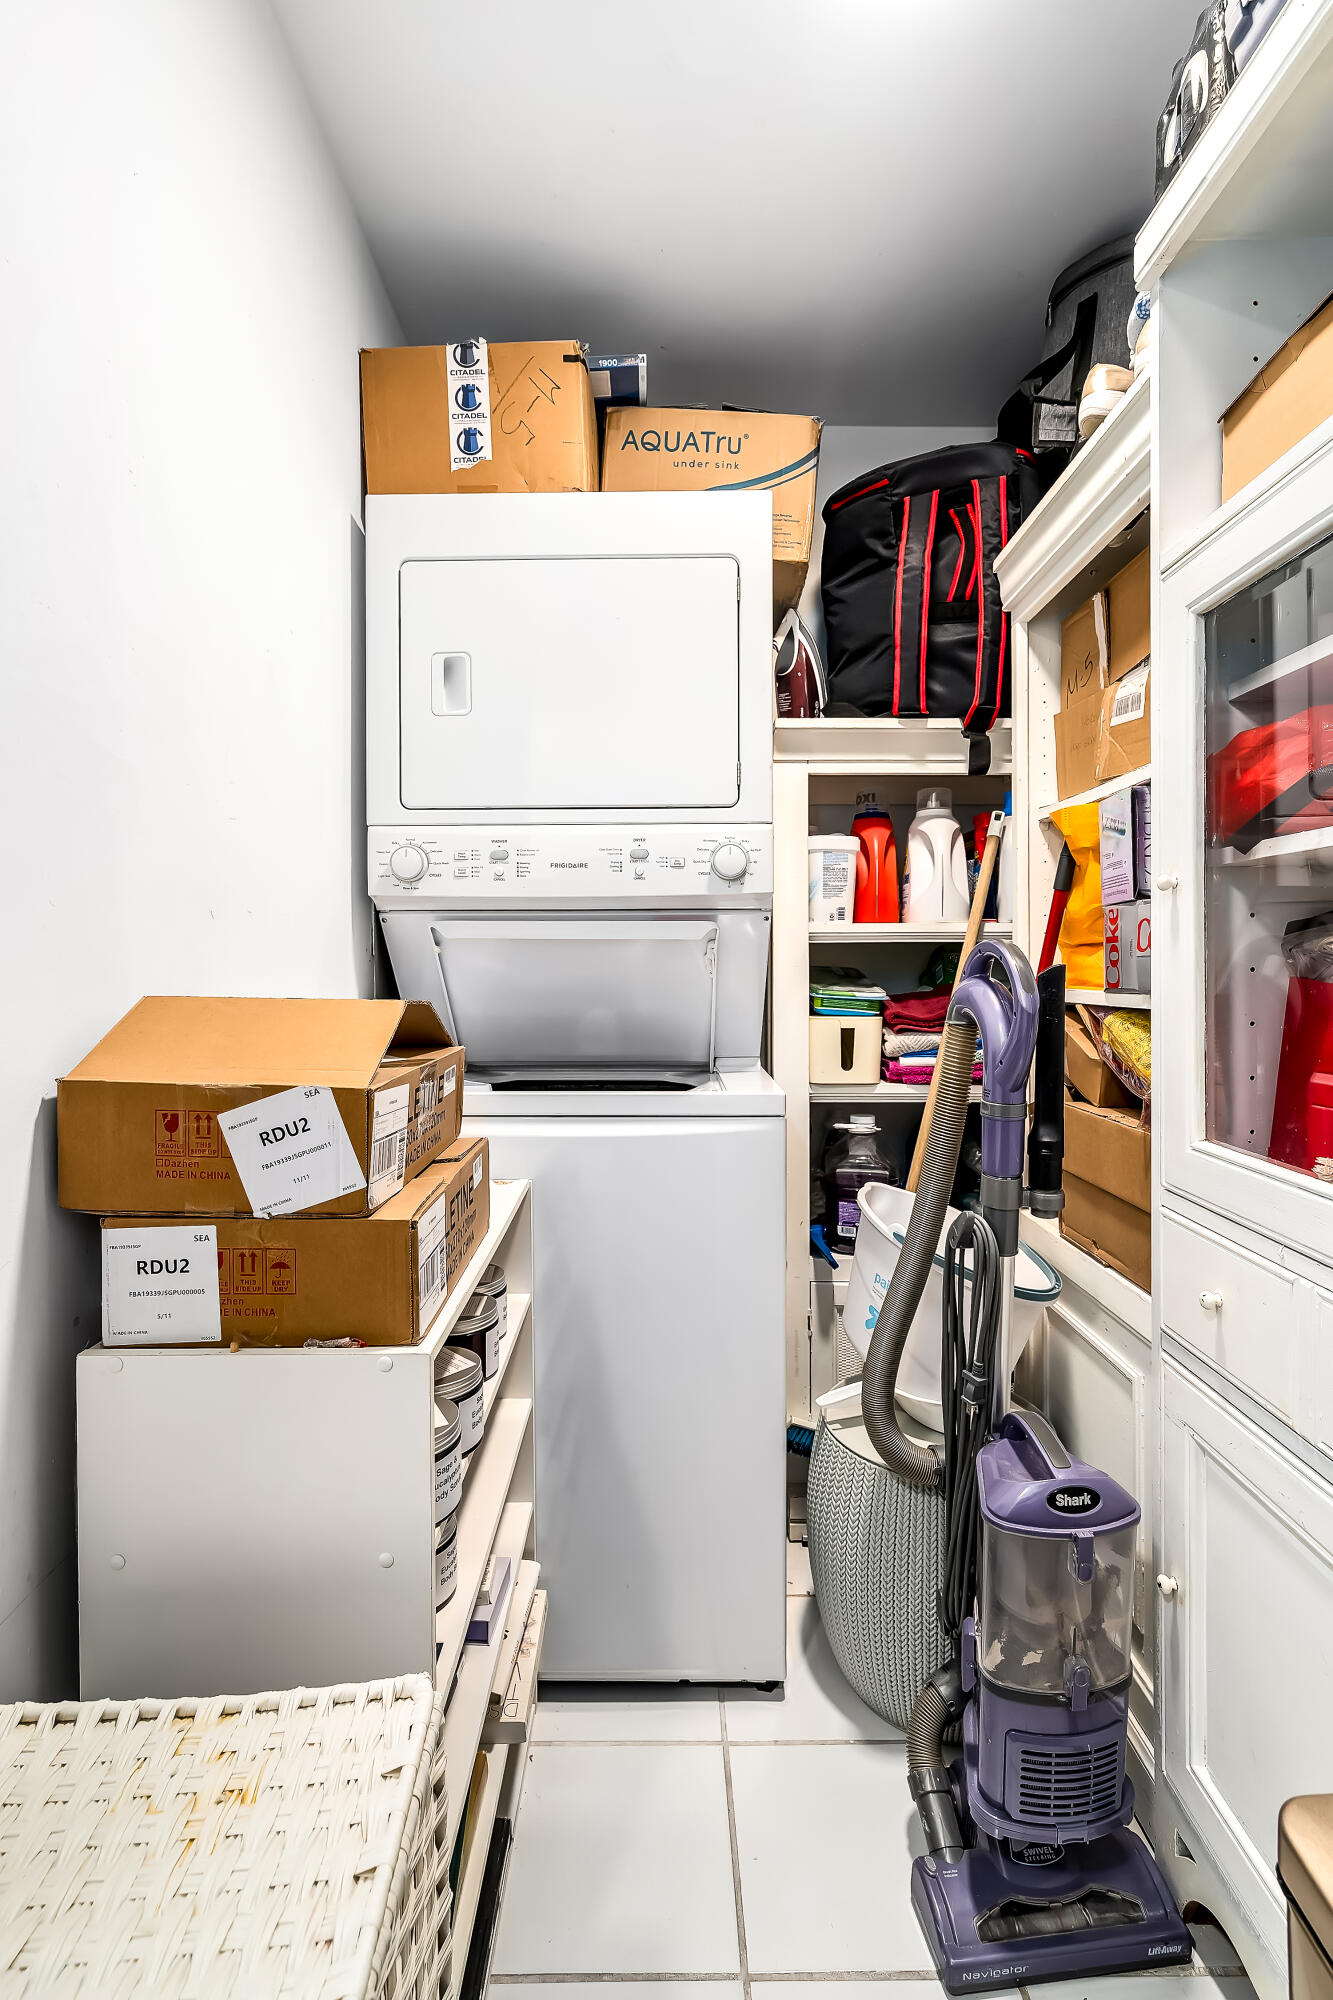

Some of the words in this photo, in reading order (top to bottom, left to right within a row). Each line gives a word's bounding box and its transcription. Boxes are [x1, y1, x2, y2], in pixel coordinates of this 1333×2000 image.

[598, 358, 618, 367] 1900
[453, 456, 487, 464] CITADE
[672, 460, 710, 469] under
[714, 460, 740, 470] sink
[1105, 907, 1121, 989] Coke
[304, 1087, 321, 1099] SEA
[259, 1117, 311, 1147] RDU2
[156, 1170, 185, 1179] MADE
[187, 1170, 197, 1179] IN
[199, 1171, 231, 1180] CHINA
[293, 1173, 310, 1184] 11/11
[193, 1234, 211, 1242] SEA
[136, 1258, 190, 1275] RDU2
[221, 1297, 244, 1306] zhen
[156, 1312, 172, 1320] 5/11
[232, 1307, 242, 1317] IN
[244, 1307, 276, 1317] CHINA
[436, 1461, 453, 1478] Sage
[435, 1489, 449, 1503] ody
[1055, 1492, 1092, 1507] Shark
[1023, 1846, 1054, 1857] SWIVEL
[1024, 1853, 1057, 1862] STEERING
[1147, 1943, 1184, 1957] Lift-Away
[962, 1965, 1029, 1981] Navigator
